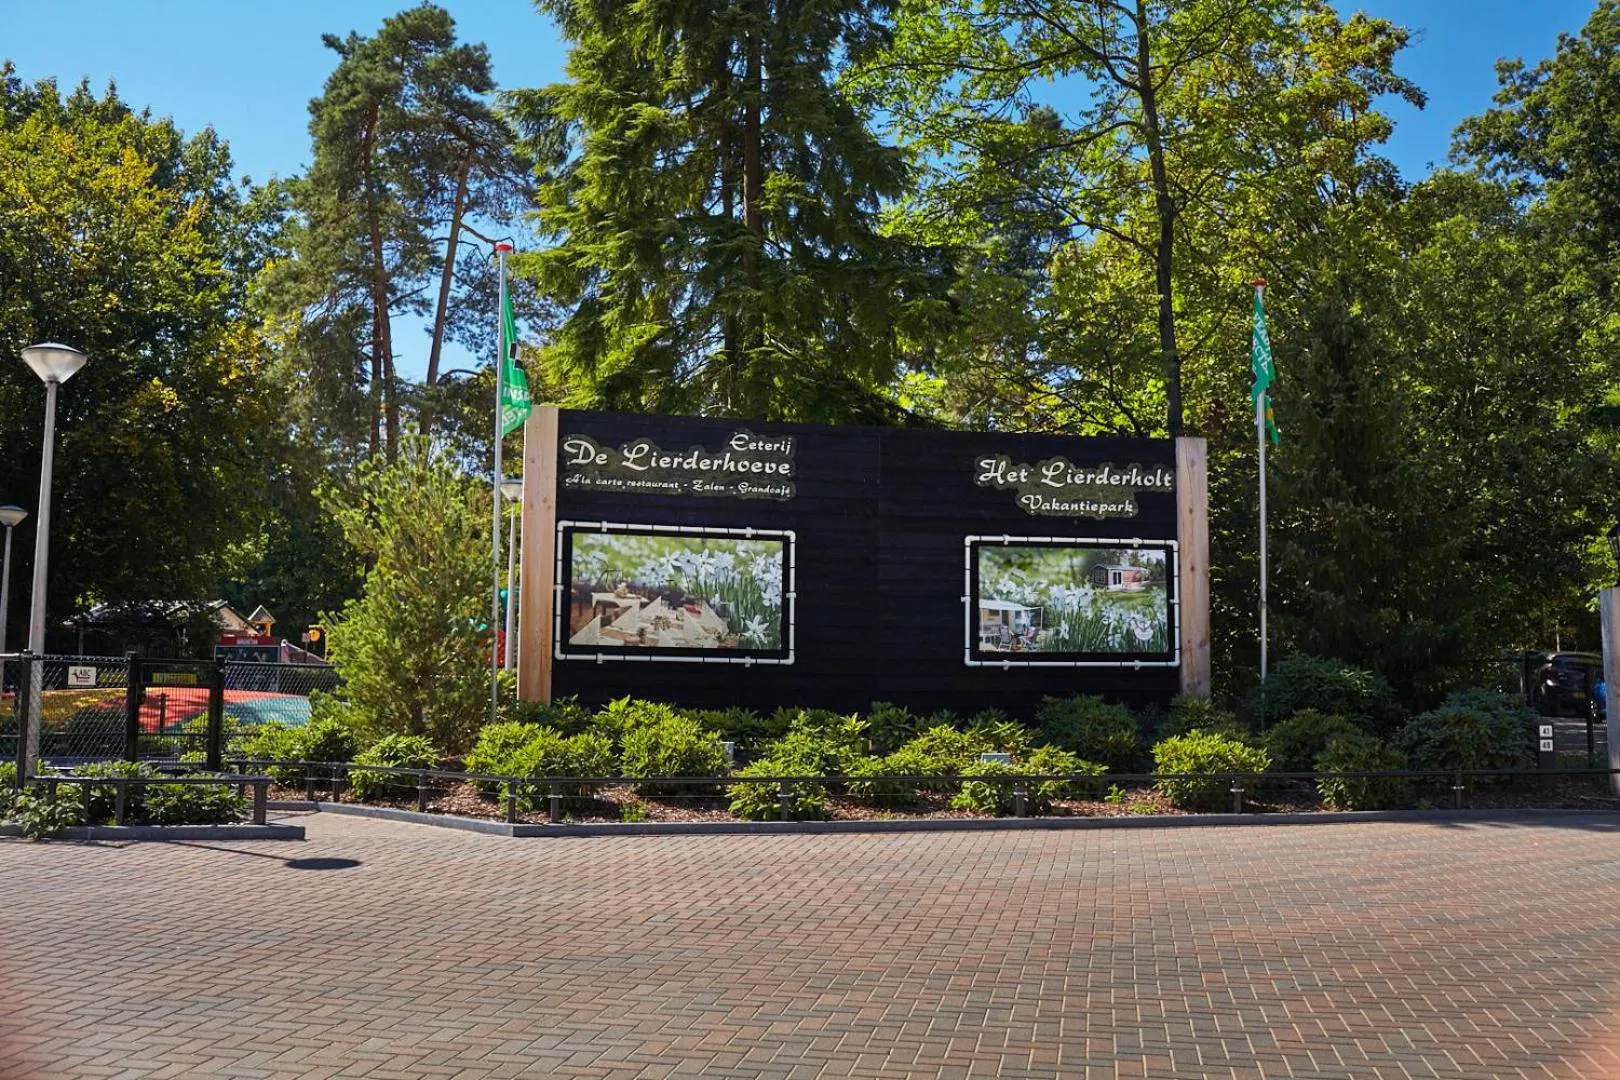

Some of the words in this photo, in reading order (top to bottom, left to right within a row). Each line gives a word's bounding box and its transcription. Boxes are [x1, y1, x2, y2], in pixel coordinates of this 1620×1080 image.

[729, 433, 791, 455] Eeterij
[563, 439, 608, 465] De
[621, 443, 791, 475] Lierderhoeve
[595, 479, 623, 487] carte
[626, 479, 679, 490] restaurant
[979, 459, 1029, 484] Het
[1041, 461, 1172, 488] Lierderholt
[1021, 494, 1133, 515] Vakantiepark
